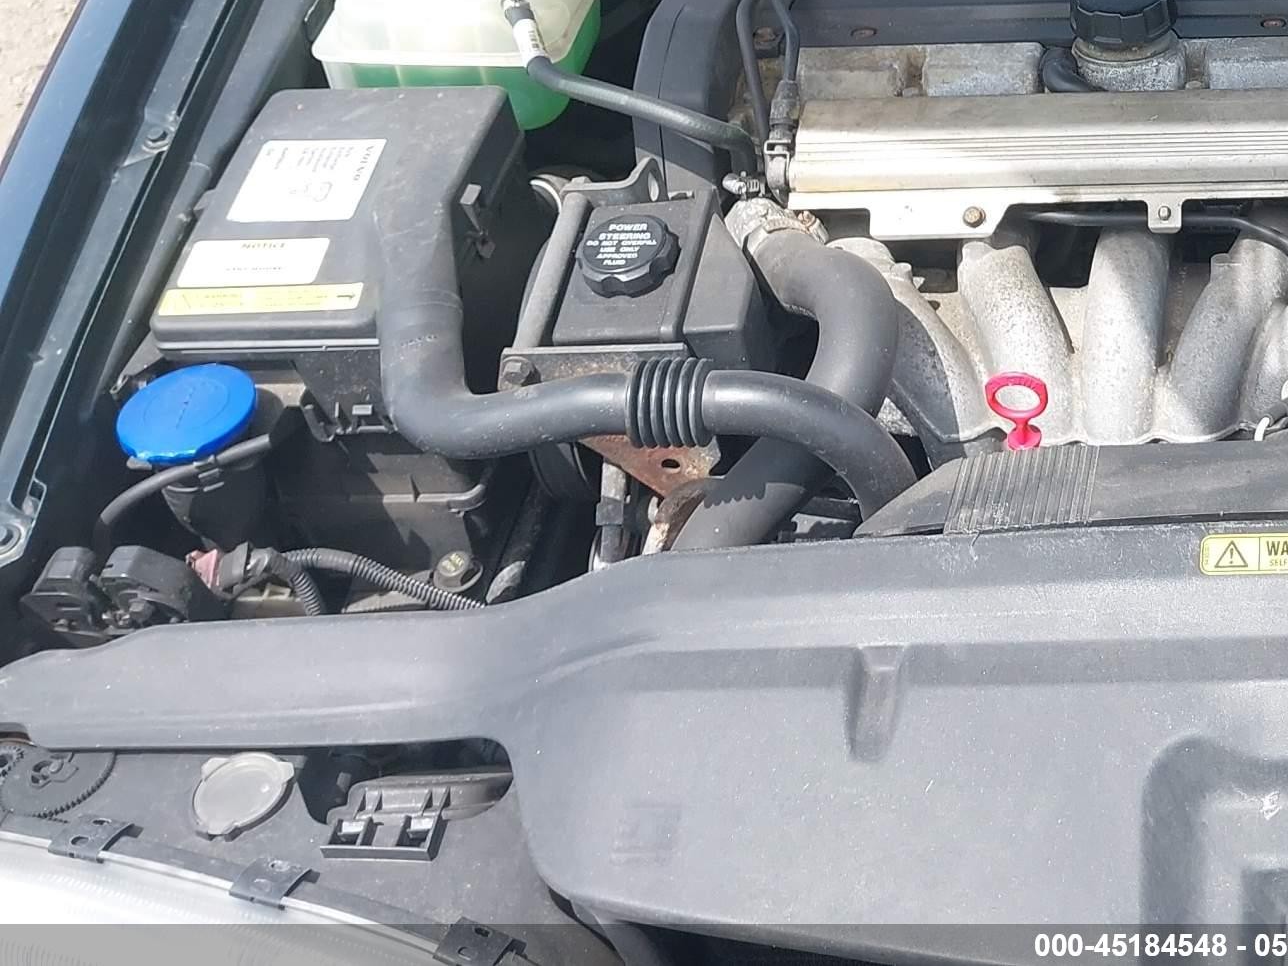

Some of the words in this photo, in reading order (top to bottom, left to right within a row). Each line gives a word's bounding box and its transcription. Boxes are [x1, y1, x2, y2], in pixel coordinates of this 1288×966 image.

[608, 223, 648, 231] POWER
[598, 232, 651, 240] STEERING
[1269, 558, 1288, 566] SELF
